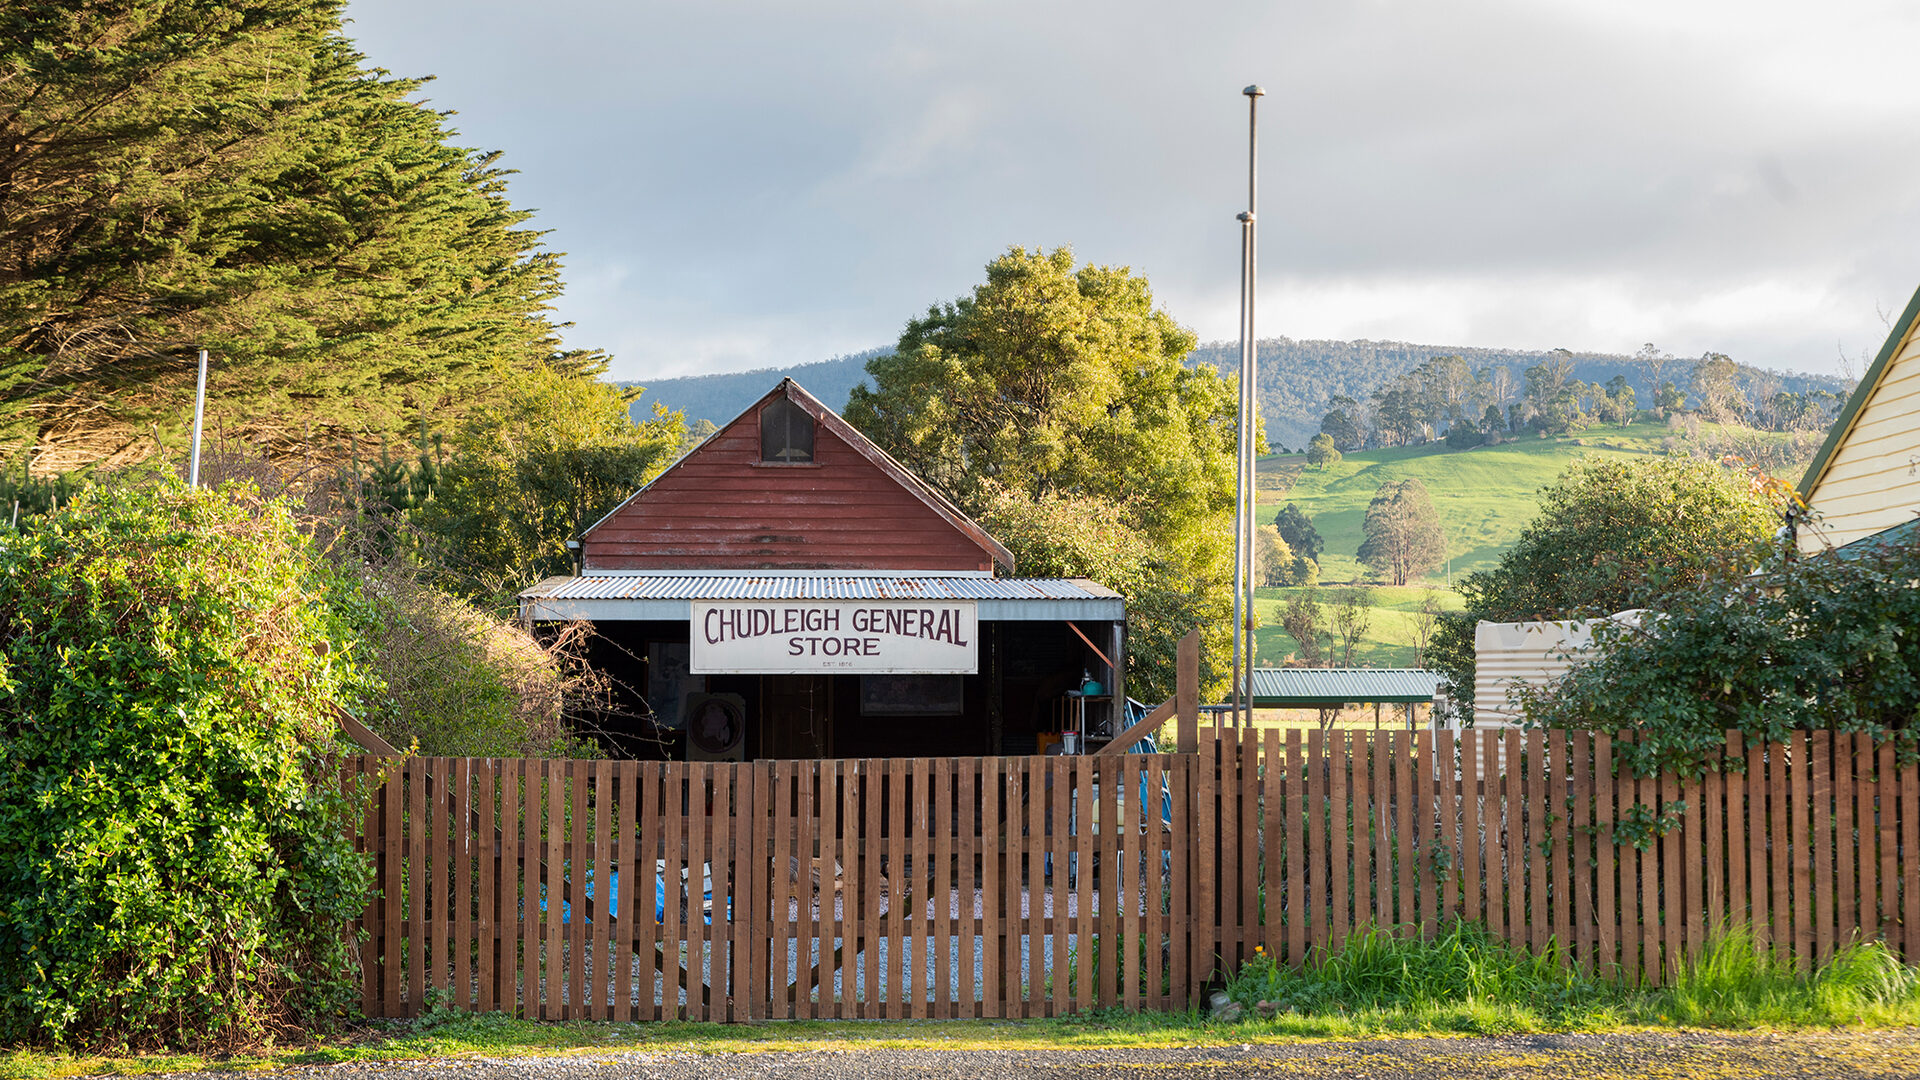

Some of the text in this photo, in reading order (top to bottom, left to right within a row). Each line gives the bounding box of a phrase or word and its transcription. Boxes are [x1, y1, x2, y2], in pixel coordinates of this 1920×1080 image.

[704, 608, 969, 648] CHUDLEIGH GENERAL
[788, 637, 881, 656] STORE
